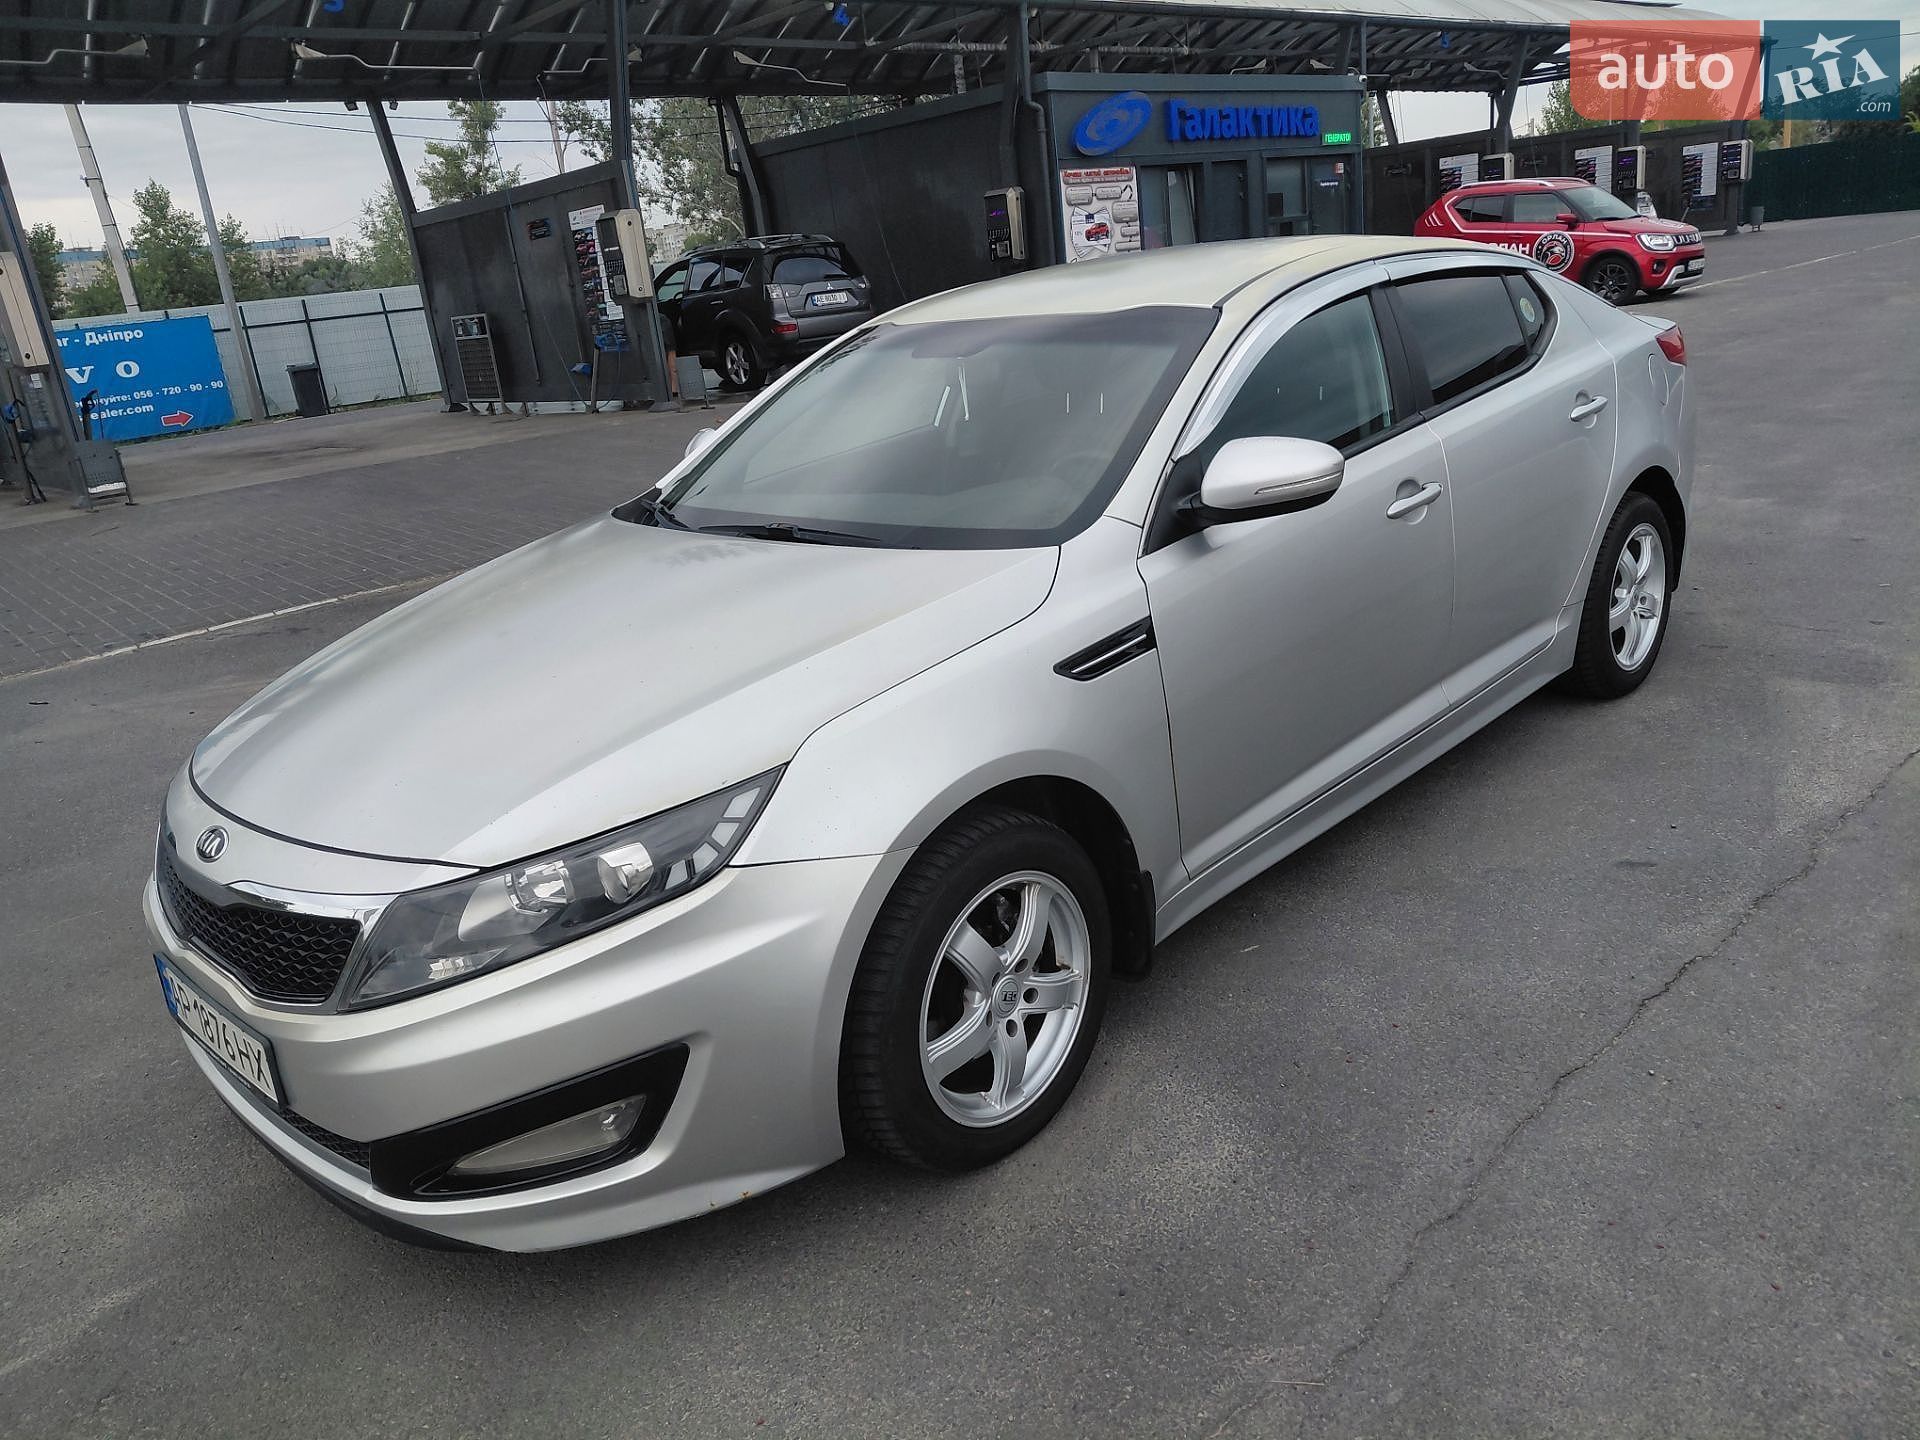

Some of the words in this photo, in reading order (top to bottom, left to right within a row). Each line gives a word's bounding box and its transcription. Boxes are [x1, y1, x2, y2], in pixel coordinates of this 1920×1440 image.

[1165, 98, 1320, 142] Галактика
[1541, 234, 1568, 246] ОРЛАН
[85, 329, 144, 346] Дніпро
[133, 389, 154, 400] 056
[162, 386, 181, 396] 720
[190, 383, 202, 392] 90
[211, 380, 224, 389] 90
